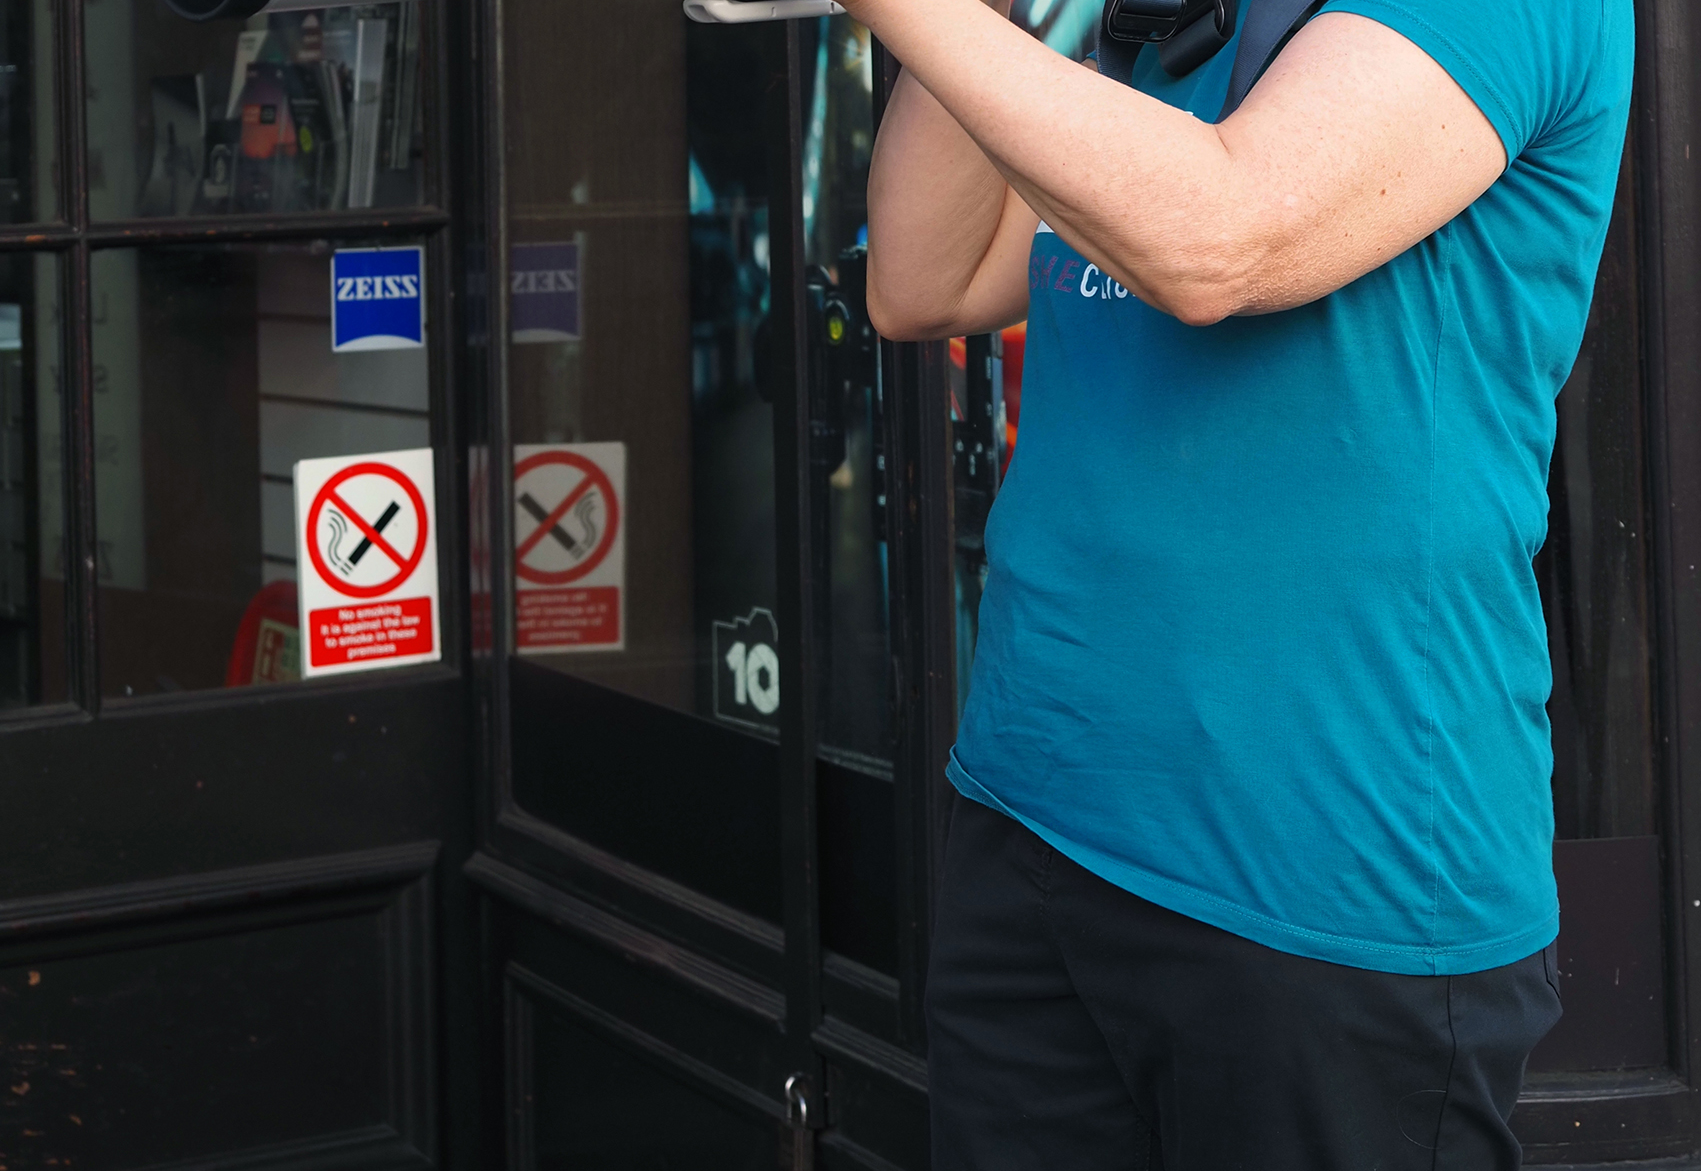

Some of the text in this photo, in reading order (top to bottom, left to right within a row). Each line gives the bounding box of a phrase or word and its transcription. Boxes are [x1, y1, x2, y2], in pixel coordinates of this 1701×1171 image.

[337, 275, 418, 301] ZEISS
[338, 605, 401, 620] No smoking
[342, 618, 381, 635] against
[382, 616, 401, 629] the
[401, 616, 420, 626] law
[325, 629, 417, 649] to smoke in these
[347, 643, 396, 659] premises
